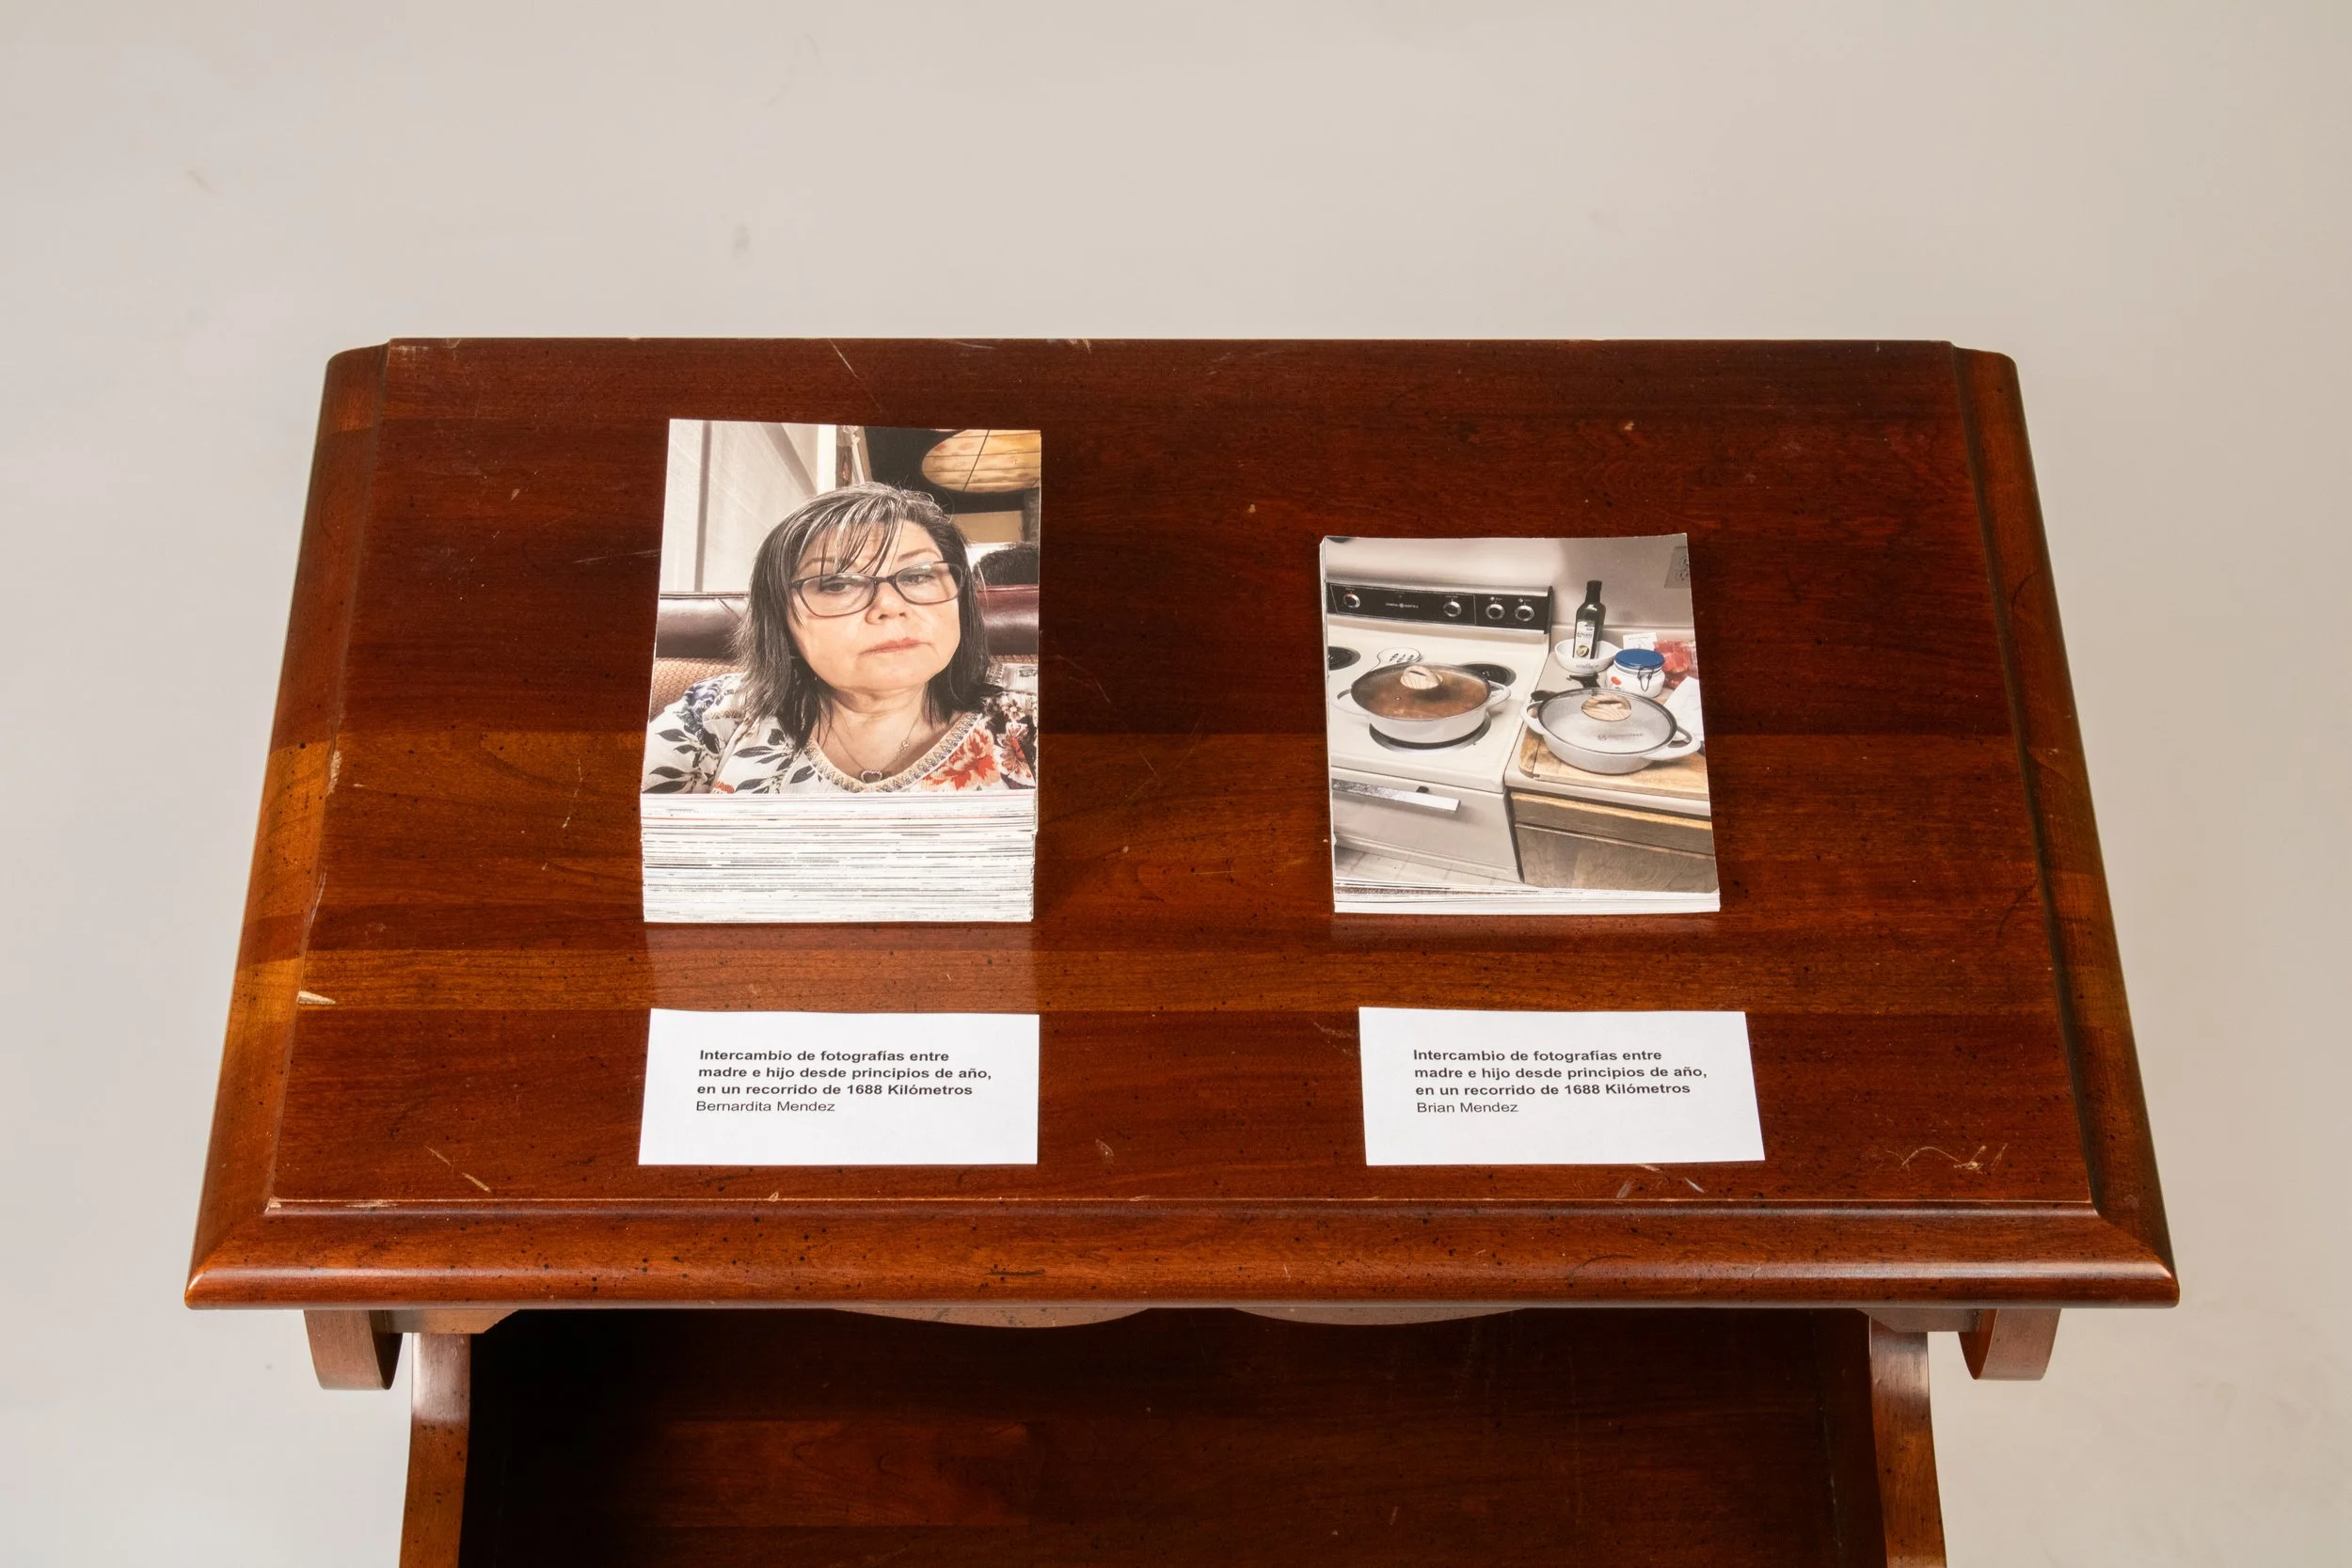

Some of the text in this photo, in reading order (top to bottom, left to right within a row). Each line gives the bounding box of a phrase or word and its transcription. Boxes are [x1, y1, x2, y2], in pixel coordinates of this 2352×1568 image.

[699, 1049, 949, 1064] Intercambio de fotografías entre
[1413, 1049, 1662, 1064] Intercambio de fotografías entre
[698, 1067, 992, 1081] madre e hijo desde principios de año,
[1414, 1066, 1708, 1081] madre e hijo desde principios de año,
[696, 1084, 973, 1096] en un recorrido de 1688 Kilómetros
[1415, 1083, 1692, 1096] en un recorrido de 1688 Kilómetros
[695, 1101, 835, 1112] Bernardita Mendez
[1416, 1101, 1518, 1114] Brian Mendez
